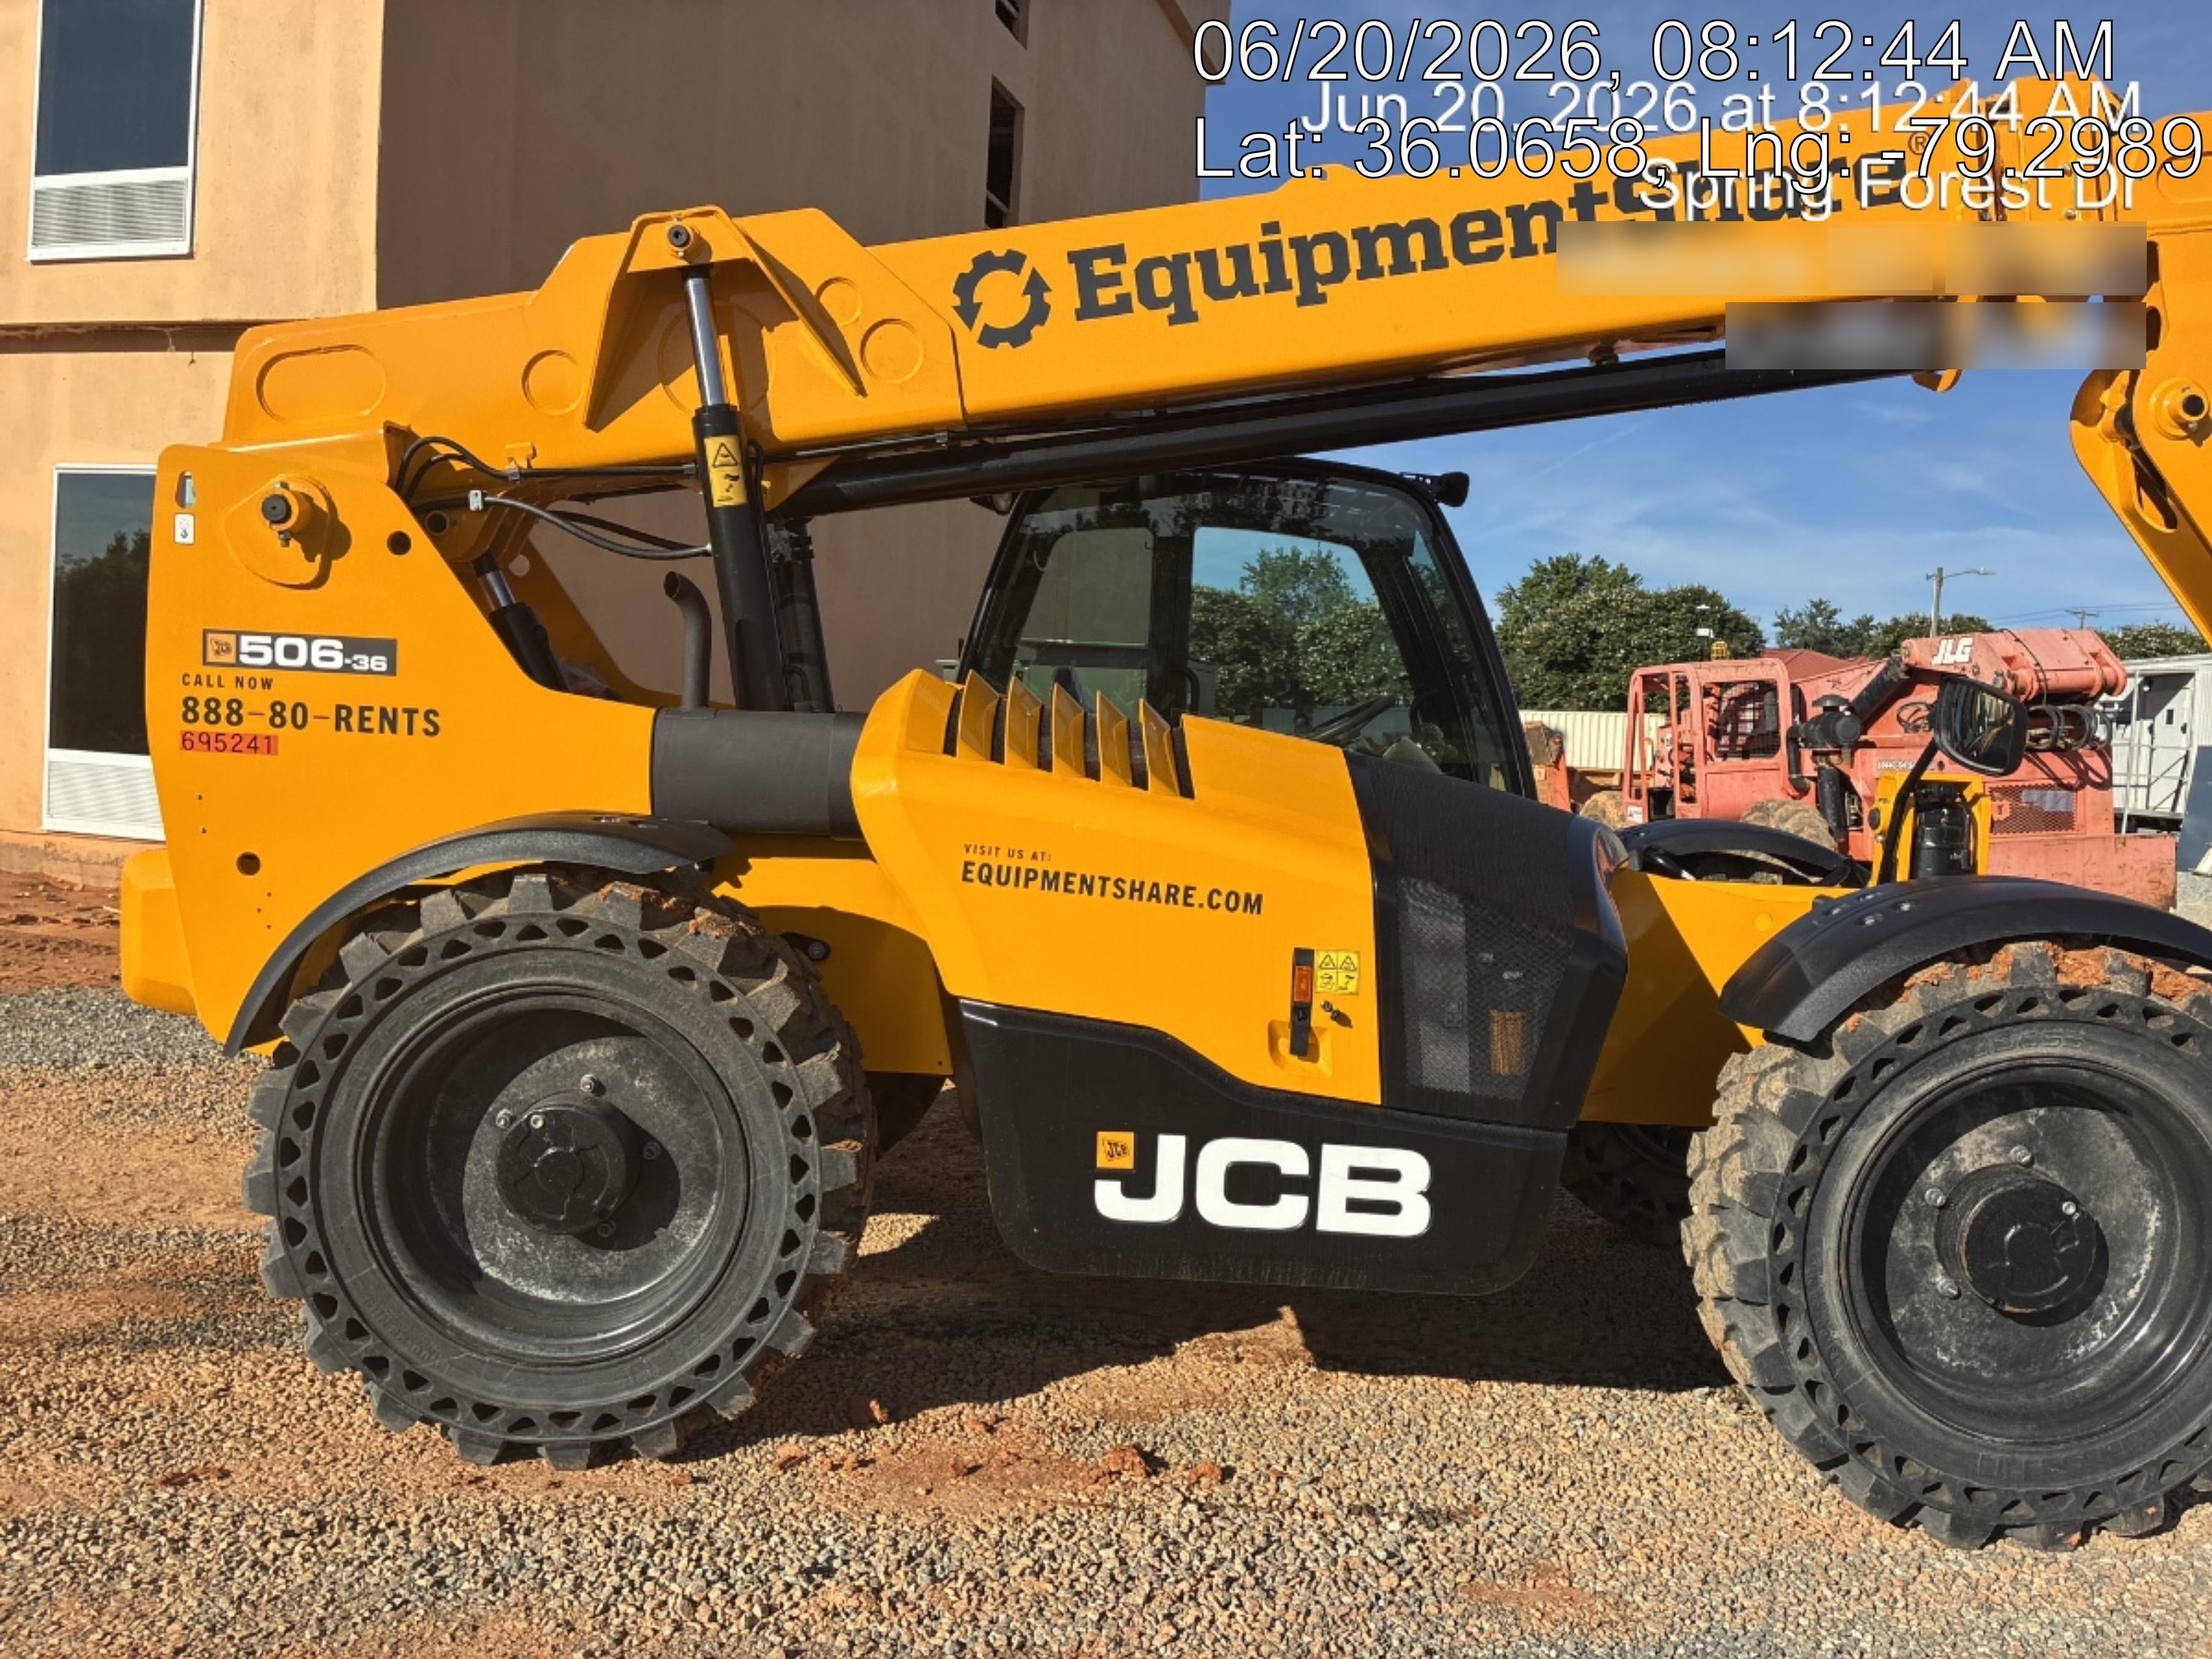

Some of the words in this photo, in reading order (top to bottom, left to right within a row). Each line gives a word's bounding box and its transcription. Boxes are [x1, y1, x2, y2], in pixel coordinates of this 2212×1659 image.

[1931, 637, 1973, 665] JLG
[181, 673, 226, 689] CALL
[235, 676, 274, 691] NOW
[181, 731, 274, 755] 695241
[963, 843, 1001, 858] VISIT
[1008, 848, 1025, 860] US
[1032, 850, 1053, 862] AT:
[961, 860, 1264, 916] EQUIPMENTSHARE.COM
[1094, 1133, 1432, 1237] JCB
